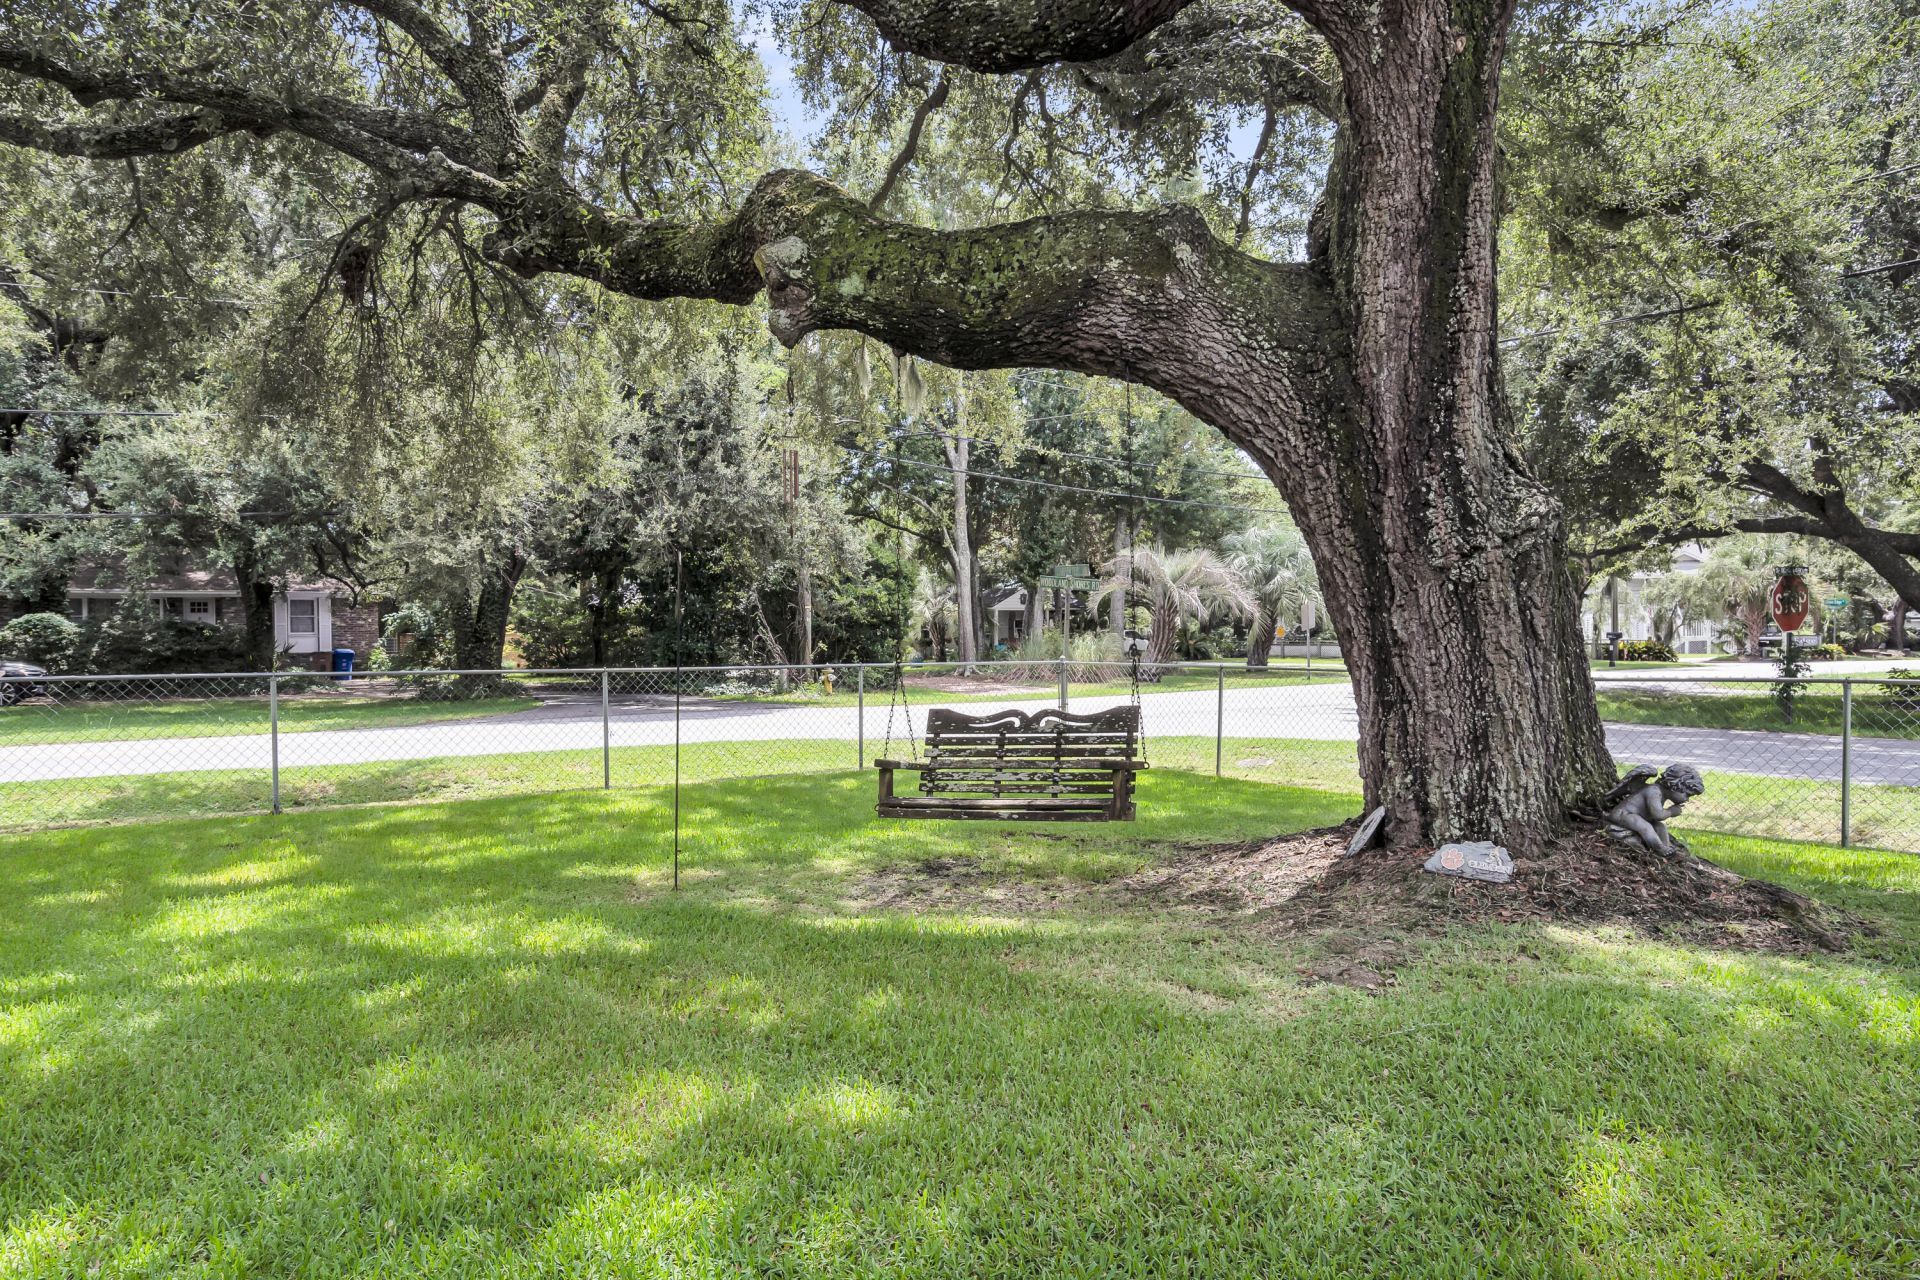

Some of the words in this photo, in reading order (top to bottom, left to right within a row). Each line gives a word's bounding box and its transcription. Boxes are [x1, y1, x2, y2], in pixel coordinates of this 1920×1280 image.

[1040, 578, 1068, 588] WOODLAND
[1070, 580, 1090, 589] SHORES
[1092, 581, 1100, 590] RD
